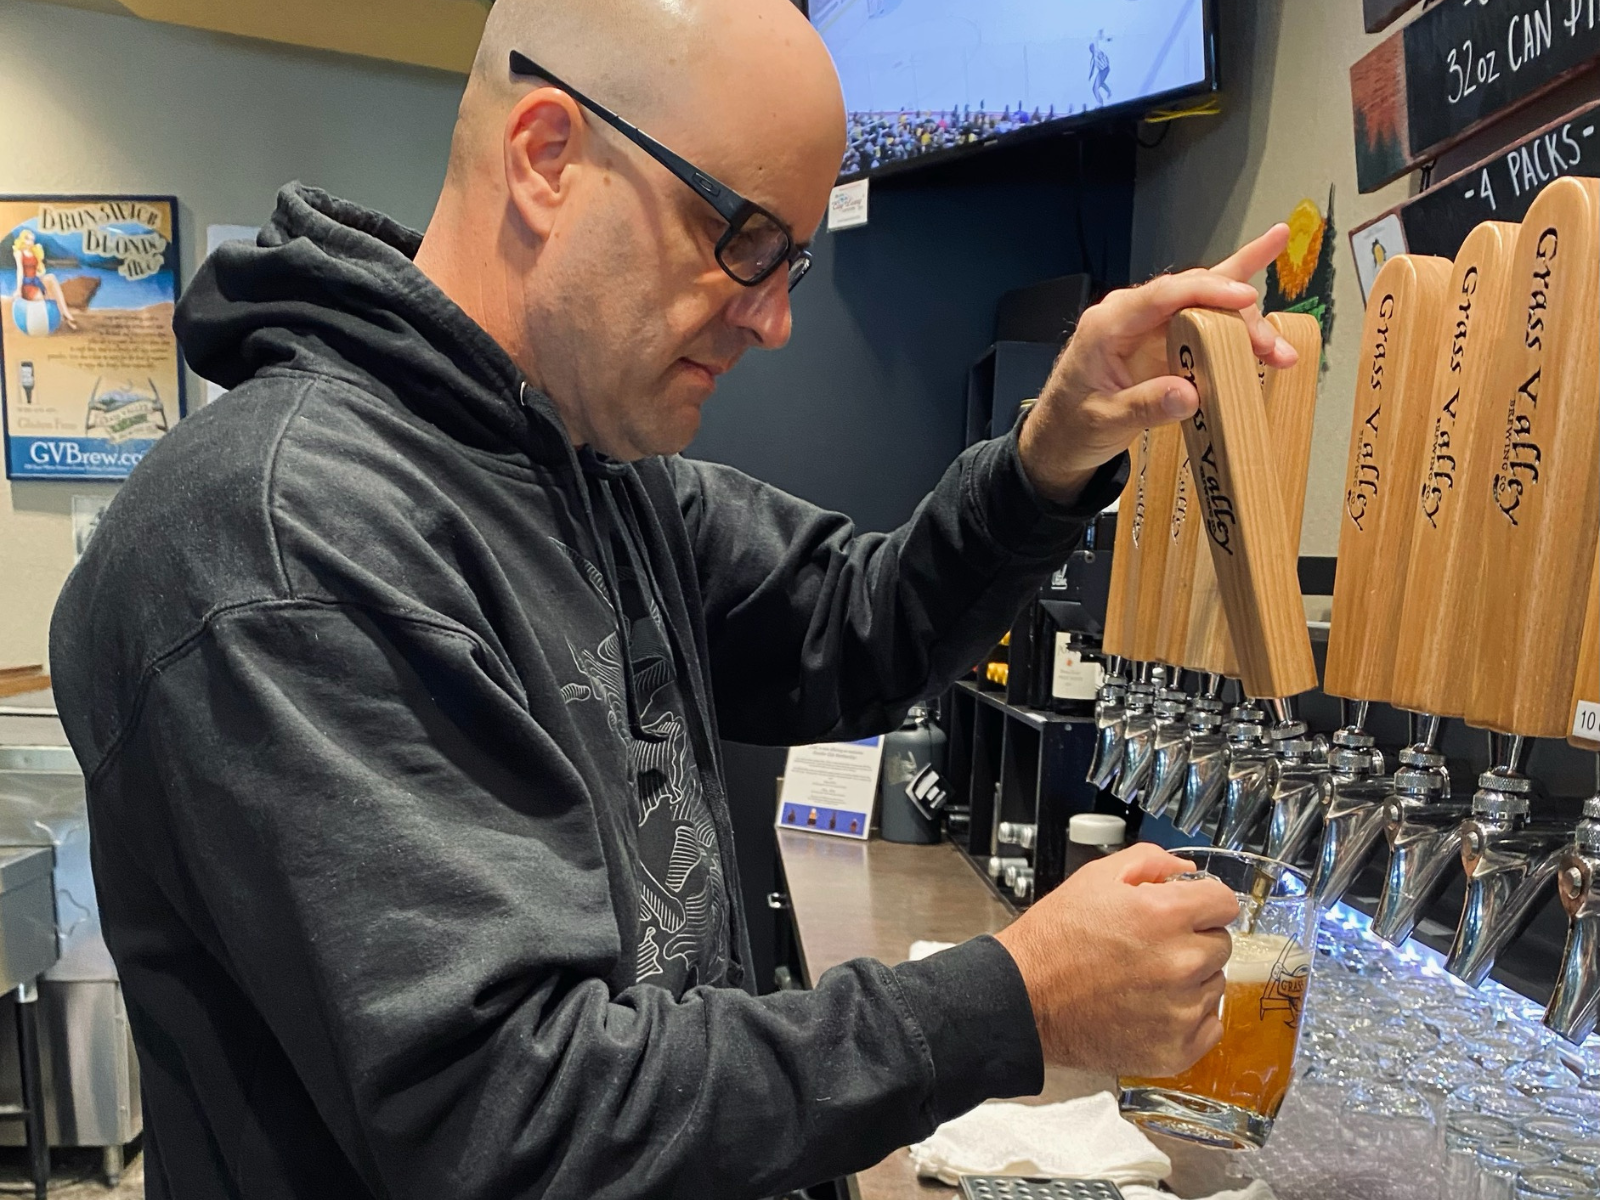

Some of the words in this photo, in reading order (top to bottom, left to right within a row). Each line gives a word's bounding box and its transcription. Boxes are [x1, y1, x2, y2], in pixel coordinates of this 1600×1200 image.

[1447, 40, 1500, 103] 32oz
[1508, 0, 1551, 72] CAN
[1564, 0, 1600, 36] PI
[1370, 293, 1394, 390] Grass
[1450, 266, 1478, 375] Grass
[1526, 227, 1558, 351] Grass
[30, 441, 146, 466] GVBrew.co
[1179, 345, 1207, 432] Grss
[1201, 441, 1236, 555] Valley
[1347, 403, 1381, 531] Valley
[1422, 387, 1460, 529] Valley
[1493, 366, 1541, 526] Valley
[1502, 399, 1515, 471] BREWING
